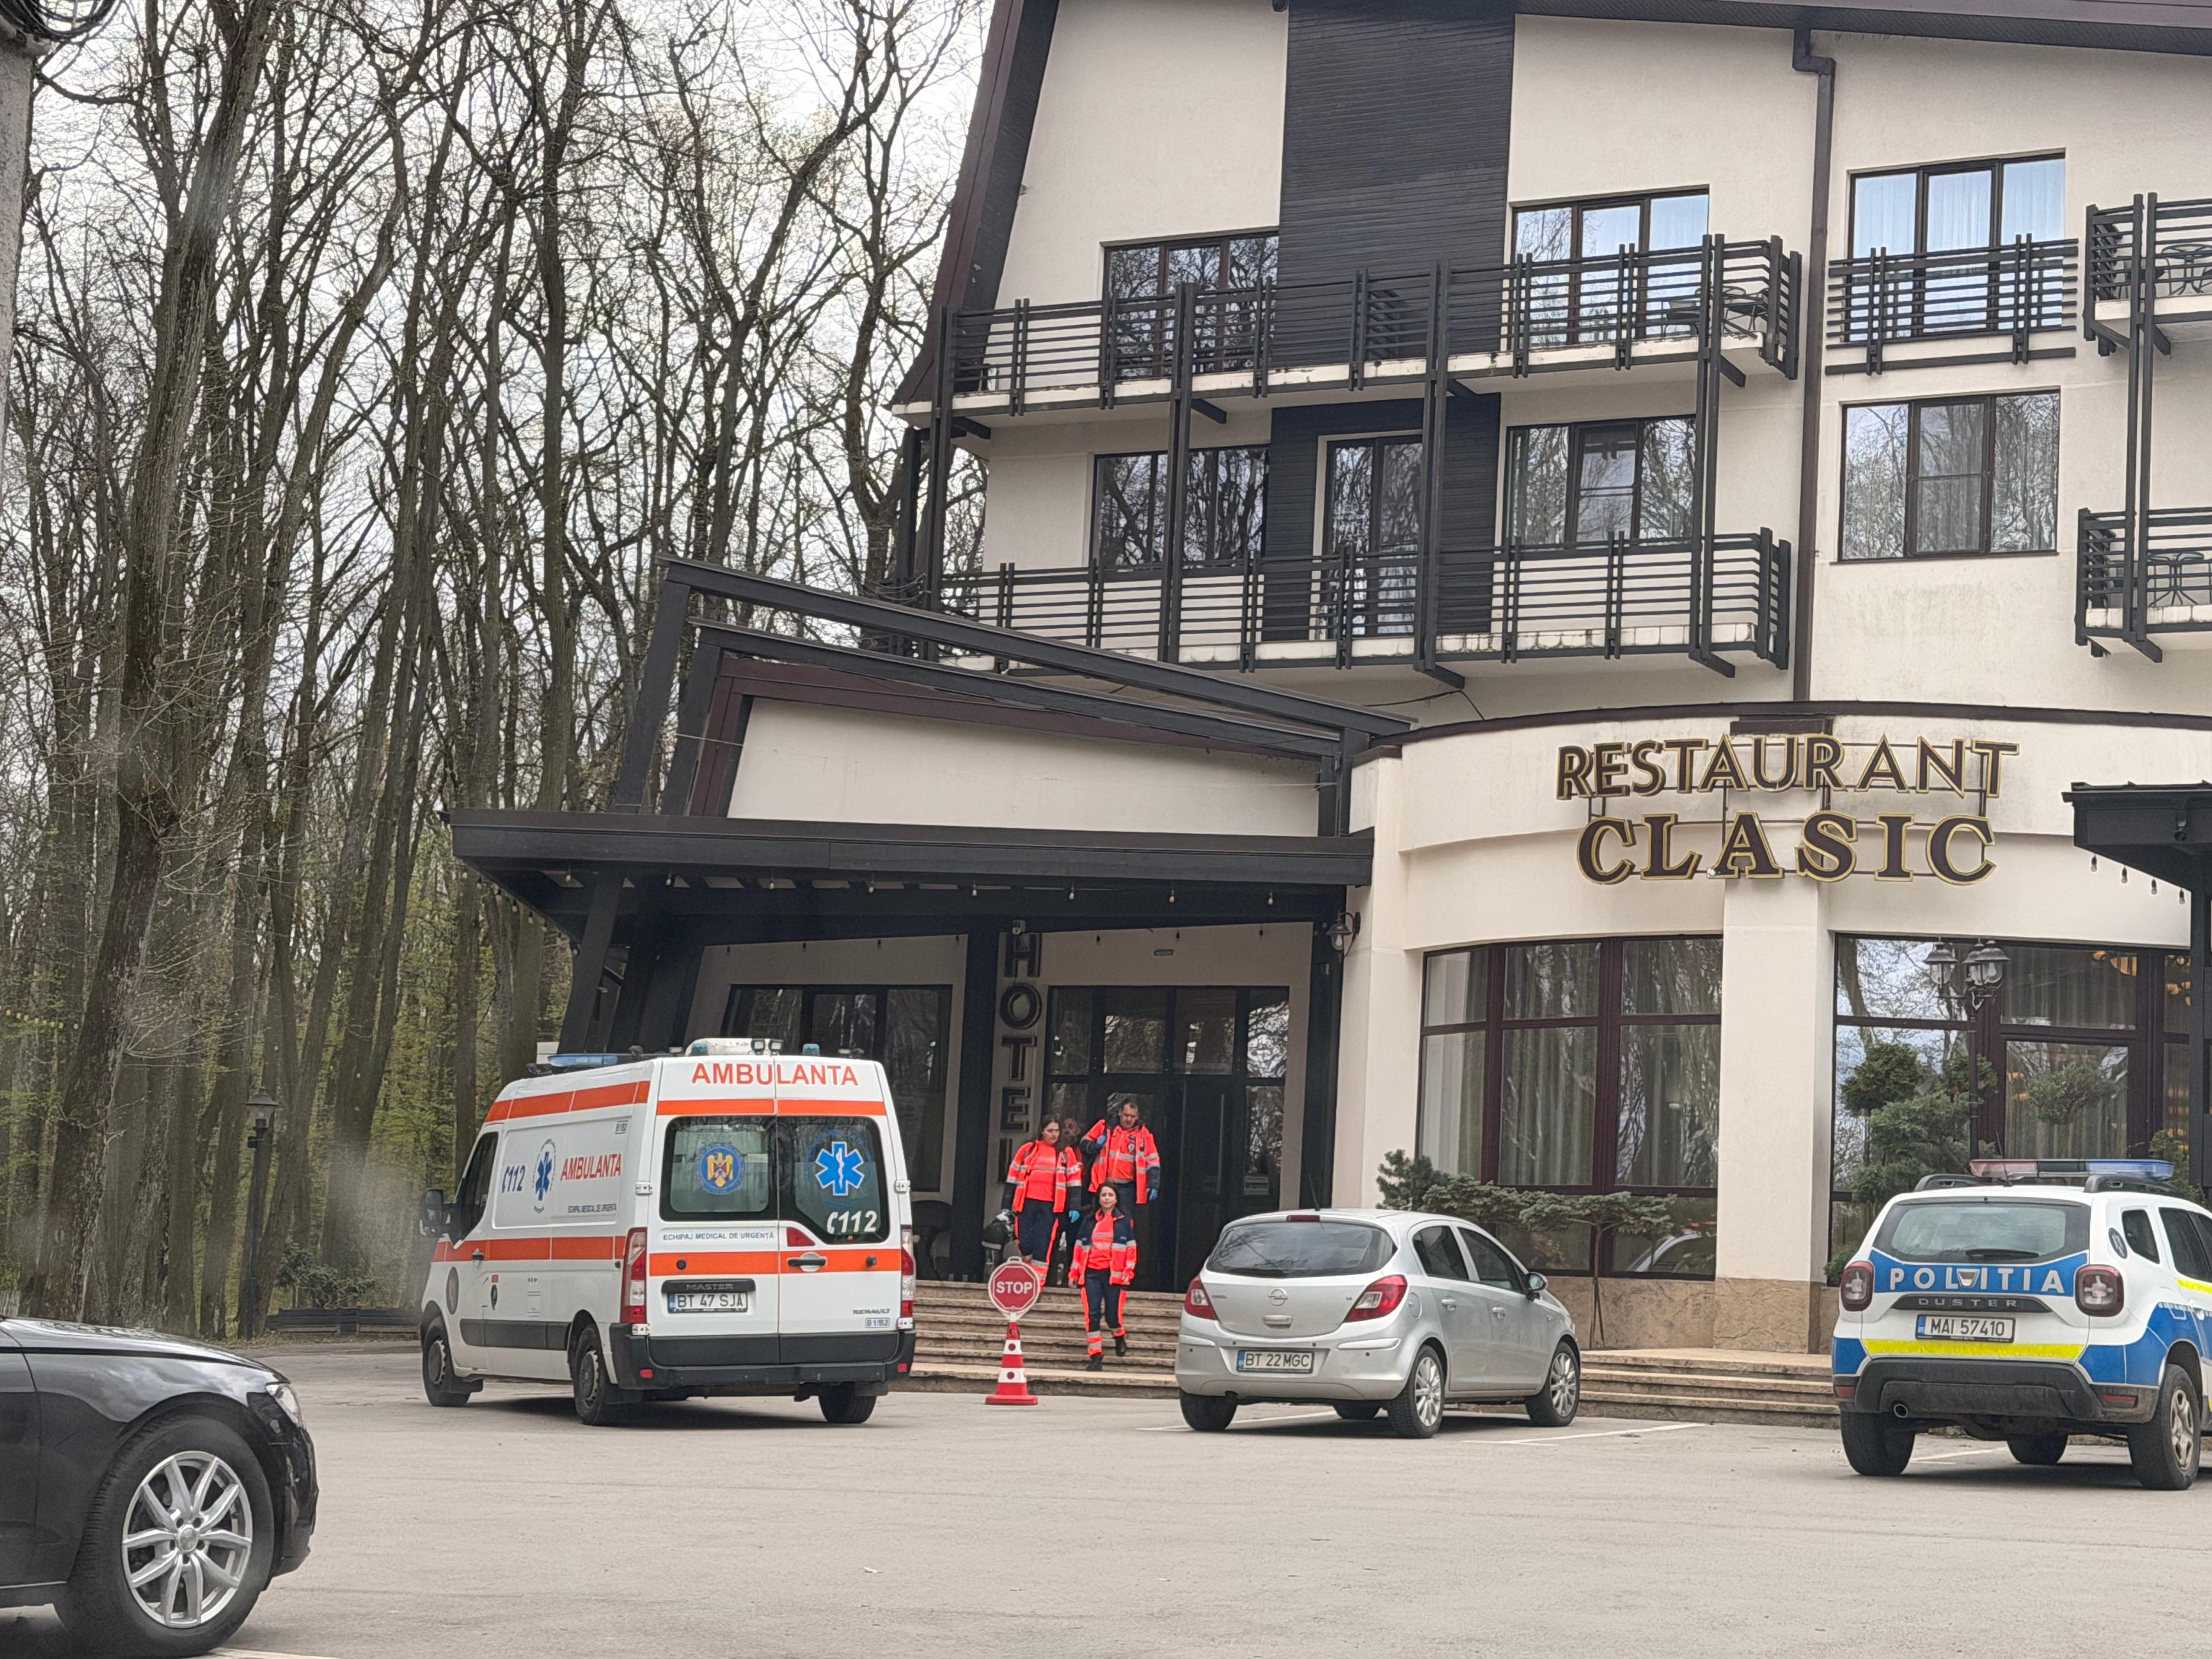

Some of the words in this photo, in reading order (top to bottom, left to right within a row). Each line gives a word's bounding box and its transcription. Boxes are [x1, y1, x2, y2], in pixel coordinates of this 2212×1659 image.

[1556, 733, 2020, 800] RESTAURANT
[1576, 810, 1997, 885] CLASIC
[691, 1063, 859, 1086] AMBULANTA
[560, 1153, 622, 1181] AMBULANTA
[996, 1281, 1032, 1294] STOP
[1889, 1267, 2065, 1293] POLITIA
[677, 1295, 695, 1307] BT
[700, 1294, 715, 1307] 47
[719, 1294, 743, 1307] SJA
[1918, 1298, 2018, 1307] DUSTER
[1930, 1318, 1955, 1335] MAI
[1960, 1319, 2005, 1336] 57410
[1245, 1353, 1262, 1366] BT
[1266, 1353, 1280, 1367] 22
[1283, 1355, 1310, 1367] MGC
